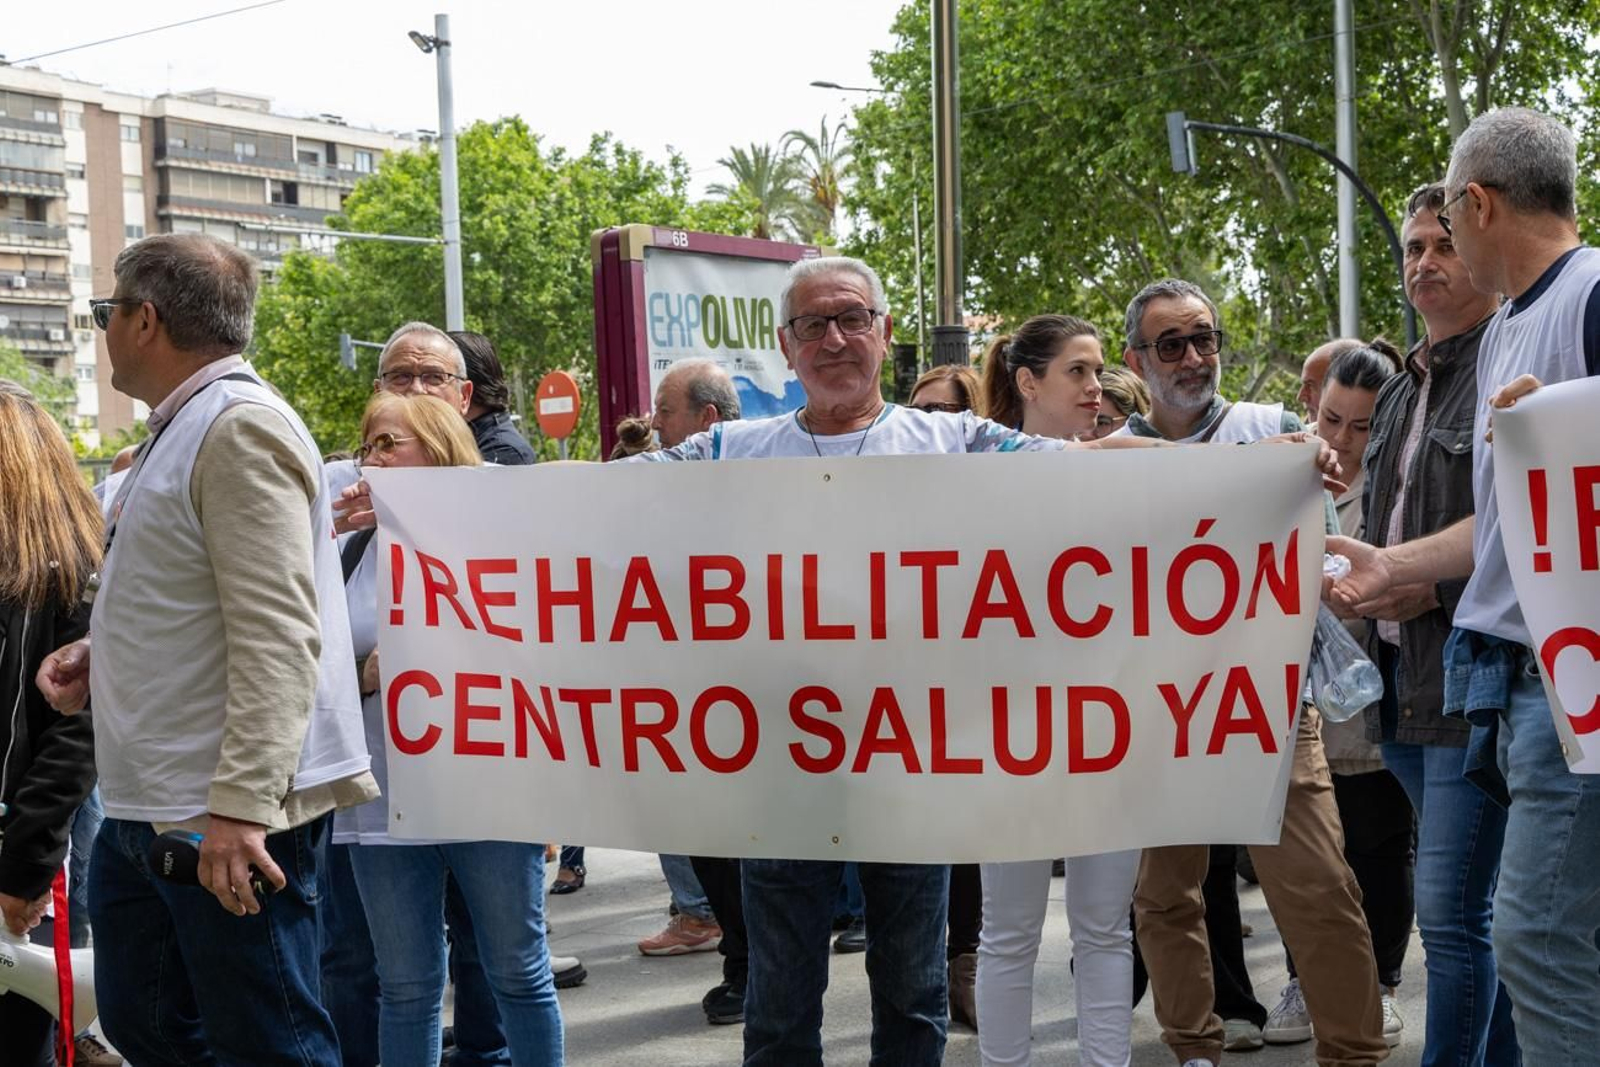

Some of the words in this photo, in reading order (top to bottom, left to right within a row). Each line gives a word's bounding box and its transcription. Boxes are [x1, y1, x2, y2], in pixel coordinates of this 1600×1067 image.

[672, 230, 689, 247] 6B
[649, 292, 776, 350] EXPOLIVA
[389, 518, 1301, 644] !REHABILITACIÓN
[387, 669, 760, 774] CENTRO
[788, 685, 1132, 776] SALUD
[1156, 663, 1300, 759] YA!
